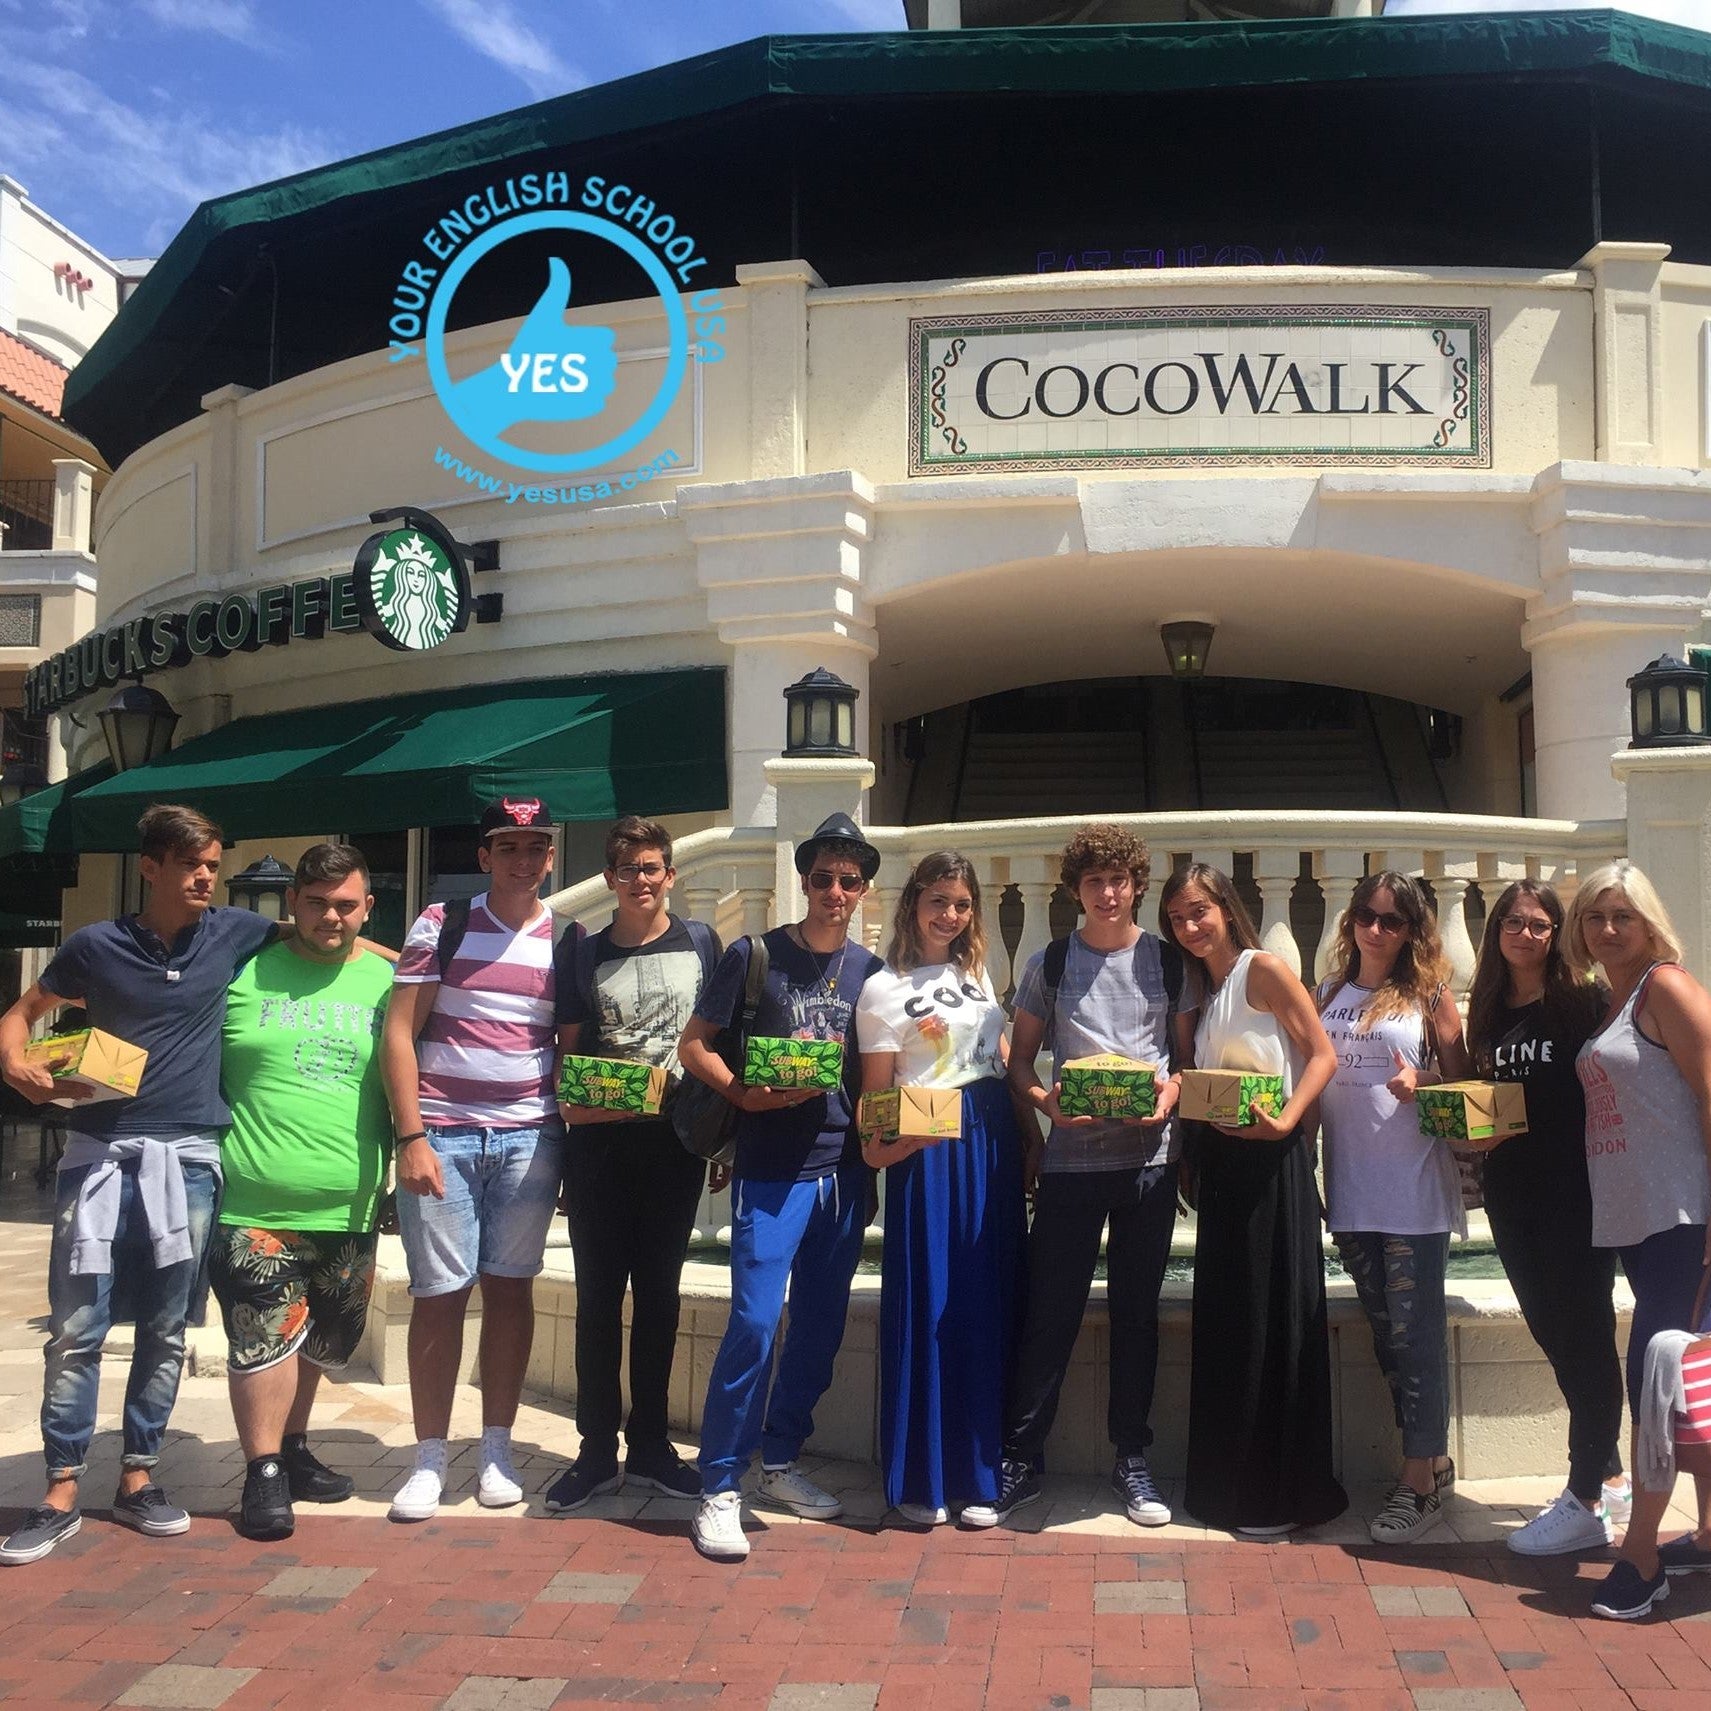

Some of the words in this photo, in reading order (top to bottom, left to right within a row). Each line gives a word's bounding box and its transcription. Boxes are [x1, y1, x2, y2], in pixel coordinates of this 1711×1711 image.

[186, 573, 360, 656] COFFE
[26, 920, 62, 928] STARB
[770, 1055, 818, 1067] SUBWAY
[1345, 1053, 1363, 1069] 92
[780, 1069, 794, 1079] to
[796, 1066, 818, 1080] go!
[582, 1075, 626, 1089] SUBWAY
[589, 1088, 604, 1099] to
[605, 1087, 625, 1101] go!
[1085, 1085, 1131, 1097] SUBWAY
[1093, 1099, 1108, 1109] to
[1111, 1095, 1132, 1110] go!
